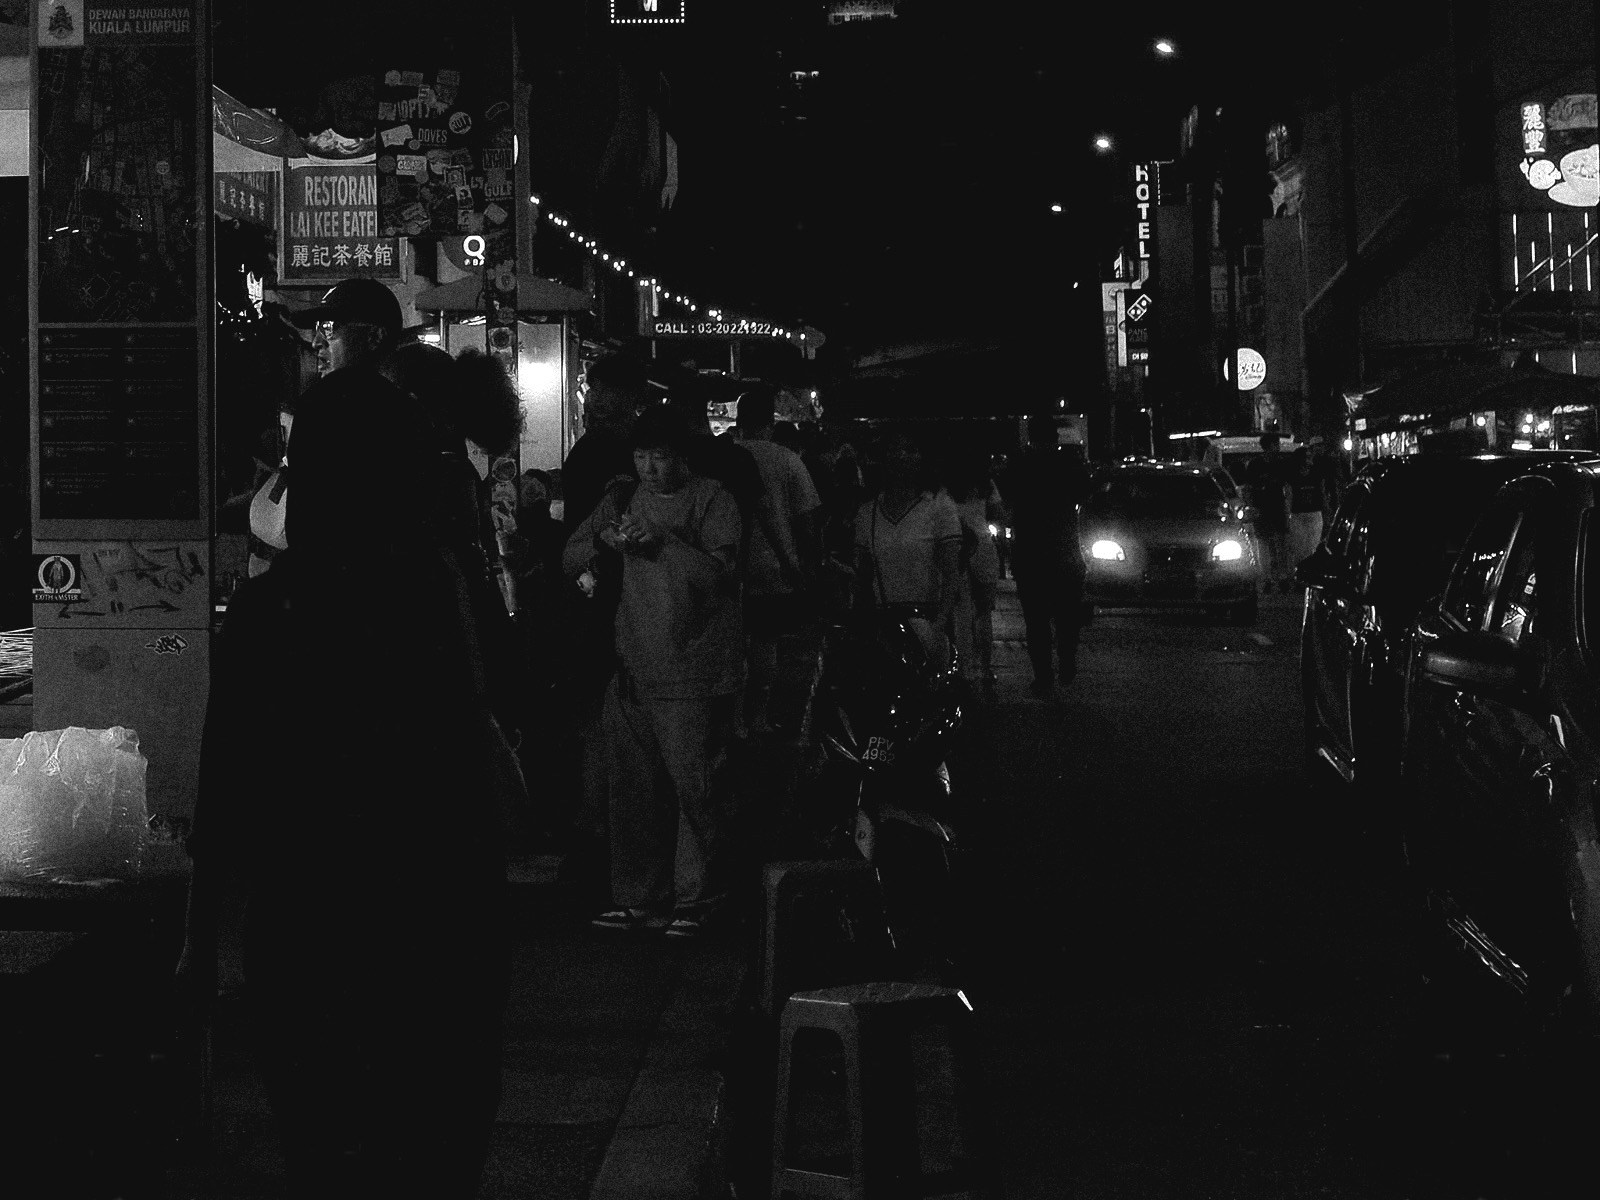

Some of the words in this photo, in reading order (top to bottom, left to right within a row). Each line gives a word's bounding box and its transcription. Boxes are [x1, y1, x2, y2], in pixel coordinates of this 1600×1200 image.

[89, 8, 126, 20] DEWAN
[129, 7, 191, 20] BANDARAYA
[89, 21, 131, 34] KUALA
[136, 20, 191, 34] LUMPUR
[418, 128, 448, 143] DOVES
[304, 175, 378, 206] RESTORAN
[290, 211, 310, 237] LAI
[314, 211, 339, 237] KEE
[291, 243, 393, 267] 麗記茶餐館
[655, 323, 688, 334] CALL
